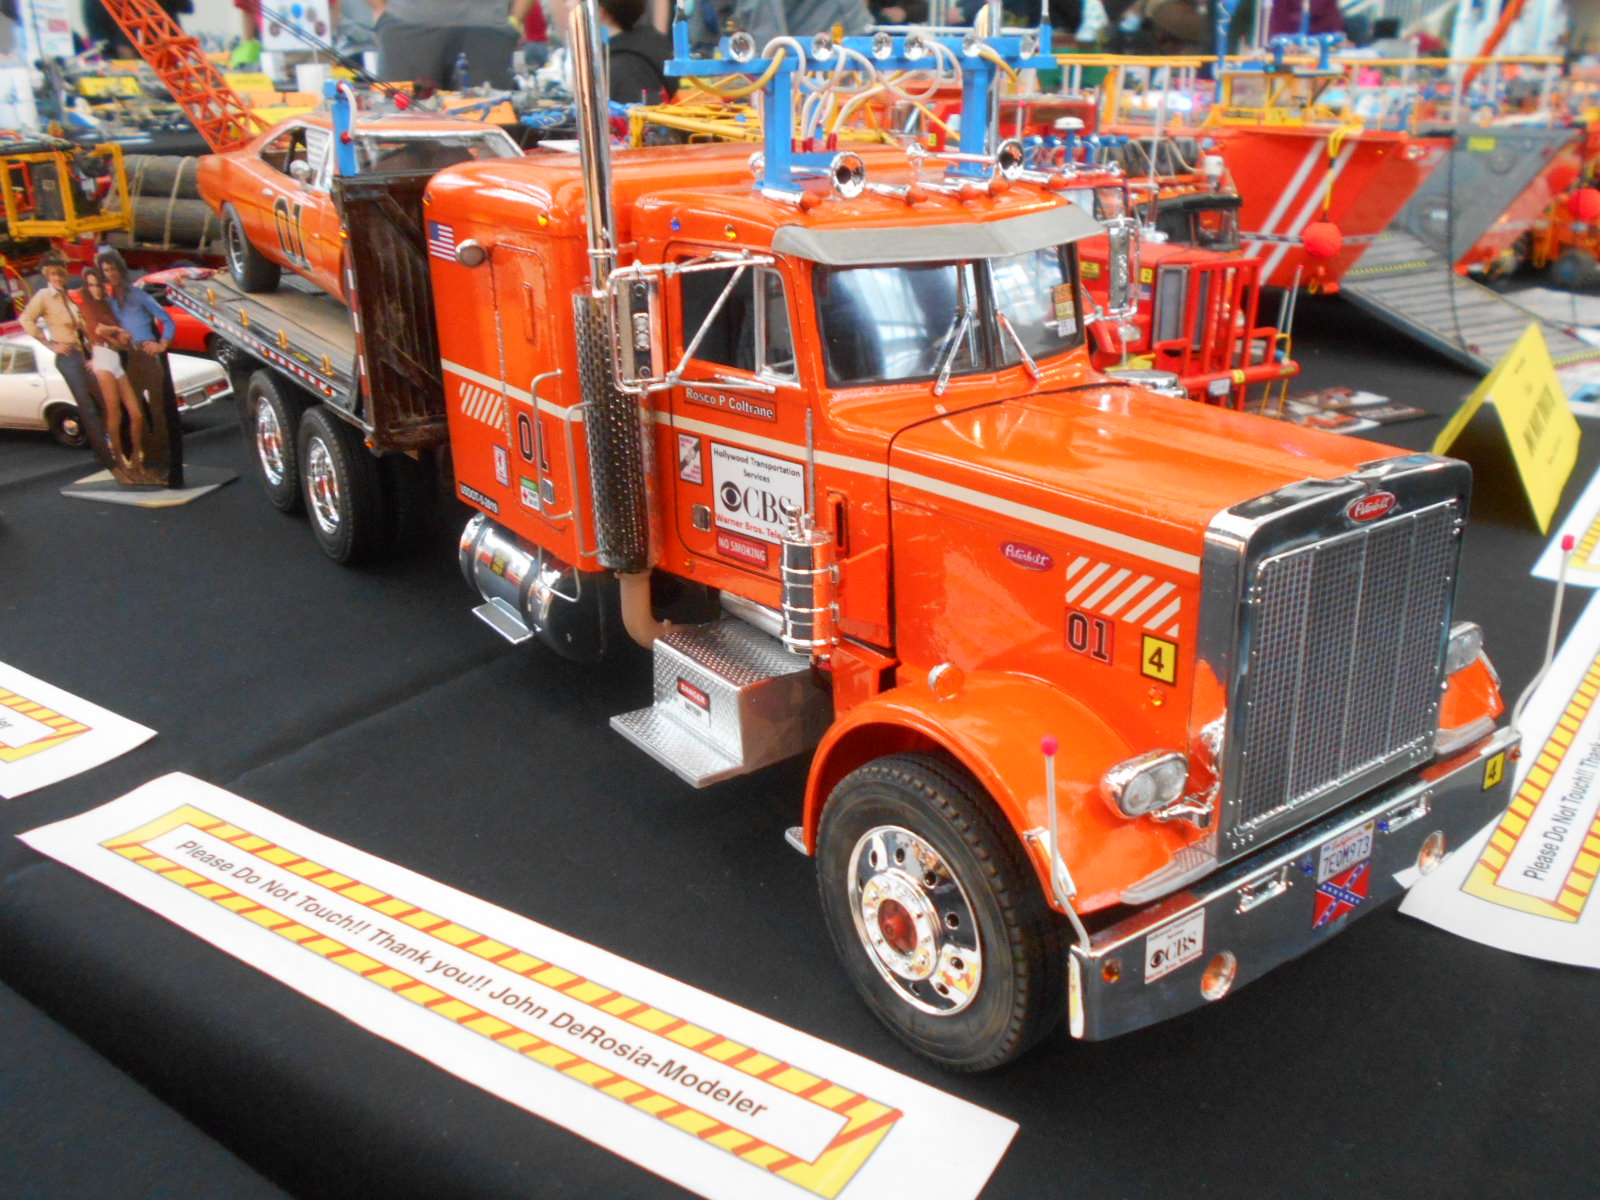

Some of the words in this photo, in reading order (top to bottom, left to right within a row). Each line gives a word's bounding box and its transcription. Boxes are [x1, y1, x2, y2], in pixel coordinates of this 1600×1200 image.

[686, 387, 716, 406] Rosco
[719, 395, 726, 406] P
[729, 398, 774, 418] Coltrane
[713, 448, 749, 464] Hollywood
[750, 457, 801, 477] Transportation
[743, 469, 771, 483] Services
[743, 486, 791, 527] CBS
[1354, 496, 1390, 518] Peterbilt
[715, 513, 743, 529] Warner
[745, 522, 766, 536] Bros.
[718, 536, 729, 548] NO
[730, 541, 766, 562] SMOKING
[1004, 544, 1050, 567] Peterbilt
[1066, 611, 1110, 664] 01
[1148, 646, 1165, 673] 4
[1561, 769, 1595, 806] Touch!!
[1552, 805, 1579, 825] Not
[1543, 826, 1568, 842] Do
[1523, 845, 1560, 881] Please
[1165, 931, 1197, 961] CBS
[175, 840, 234, 873] Please
[232, 867, 261, 884] Do
[259, 880, 298, 902] Not
[296, 895, 370, 935] Touch!!
[368, 928, 434, 966] Thank
[427, 960, 493, 992] you!!
[489, 987, 549, 1020] John
[550, 1012, 768, 1118] DeRosia-Modeler
